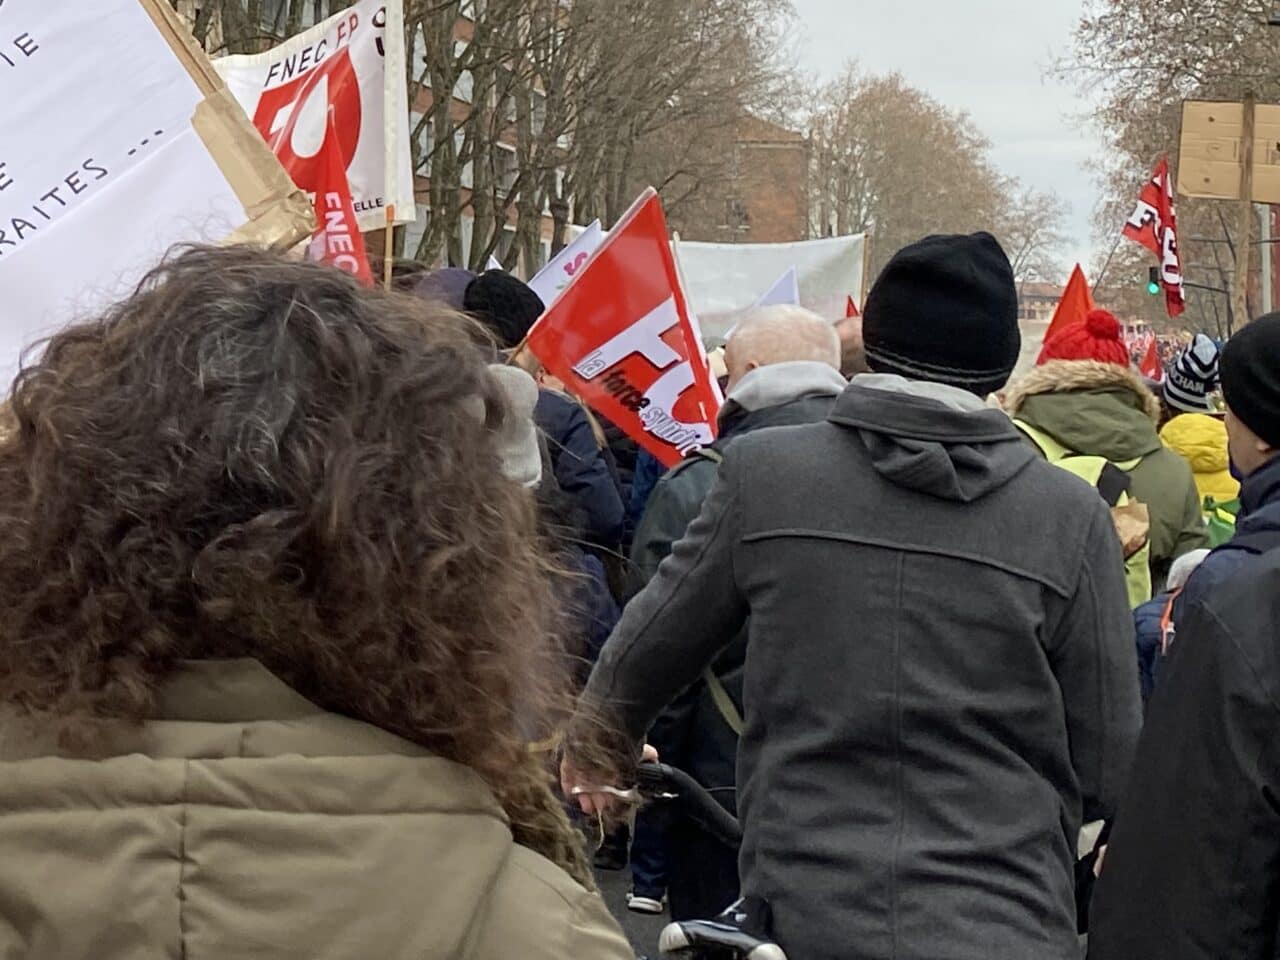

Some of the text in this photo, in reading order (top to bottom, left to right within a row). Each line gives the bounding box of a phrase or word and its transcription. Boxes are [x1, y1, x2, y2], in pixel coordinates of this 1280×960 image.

[264, 39, 328, 88] FNEC
[335, 12, 360, 49] FP
[603, 369, 651, 413] force
